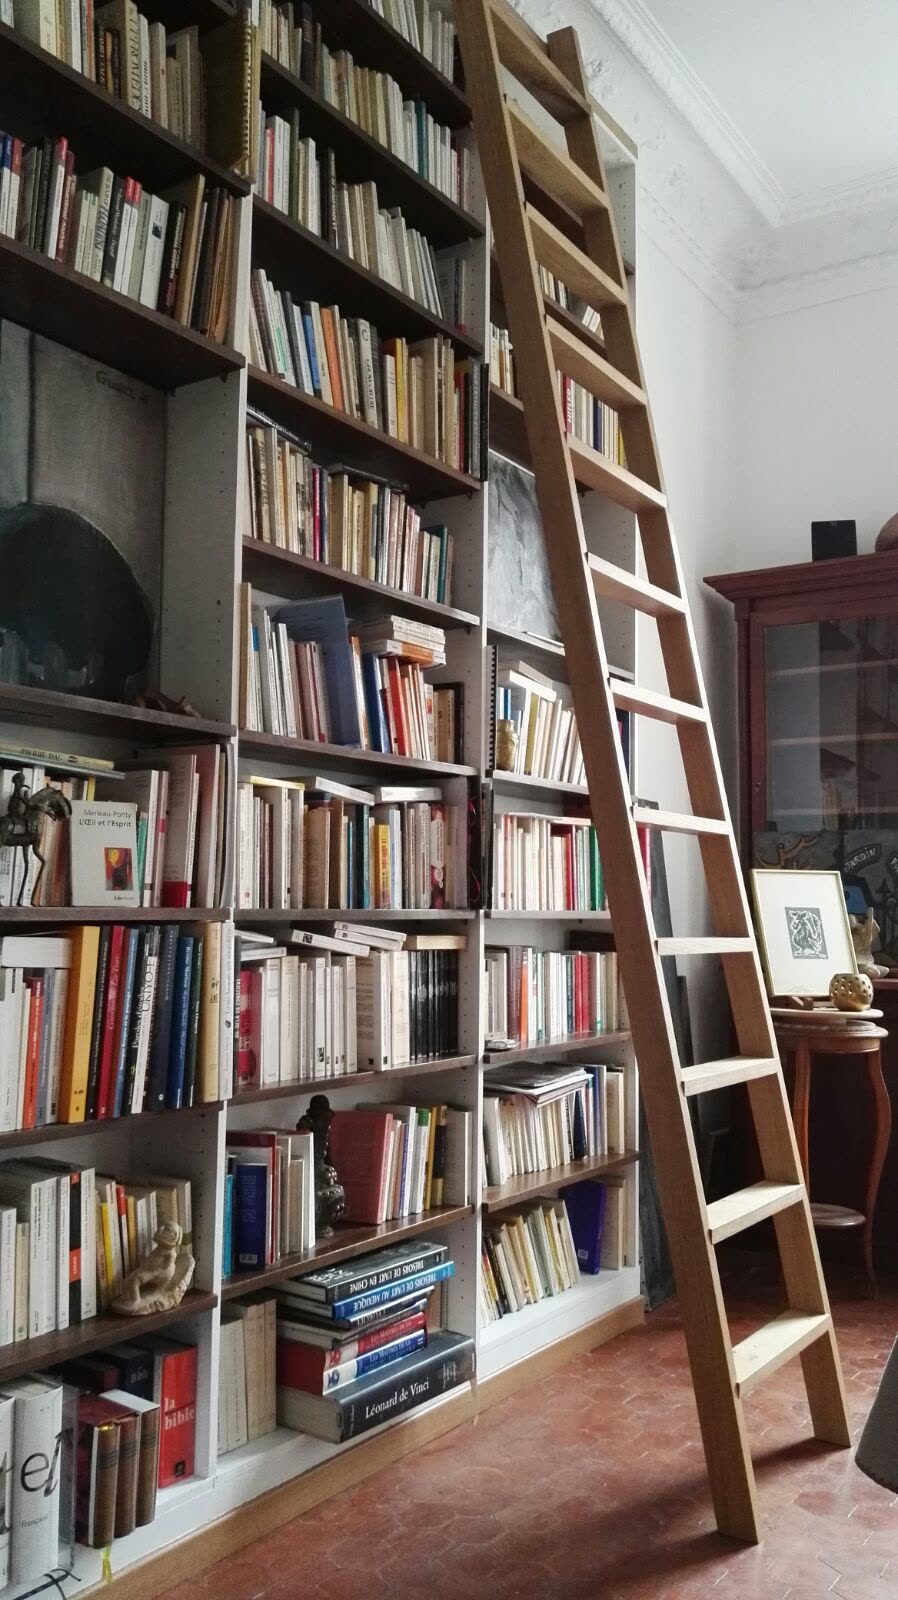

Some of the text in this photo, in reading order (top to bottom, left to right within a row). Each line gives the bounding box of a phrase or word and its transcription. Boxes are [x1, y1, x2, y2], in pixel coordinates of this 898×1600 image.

[107, 820, 132, 830] l'Esprit
[393, 1267, 401, 1276] DE
[403, 1260, 424, 1274] TRÉSORS
[369, 1275, 378, 1286] EN
[379, 1269, 393, 1283] L'ART
[350, 1278, 369, 1293] CHINE
[354, 1273, 437, 1312] TRÉSORS DE L'ART AU MEXIQUE
[164, 1397, 175, 1411] la
[365, 1377, 430, 1419] Léonard de Vinci
[164, 1408, 195, 1431] bible
